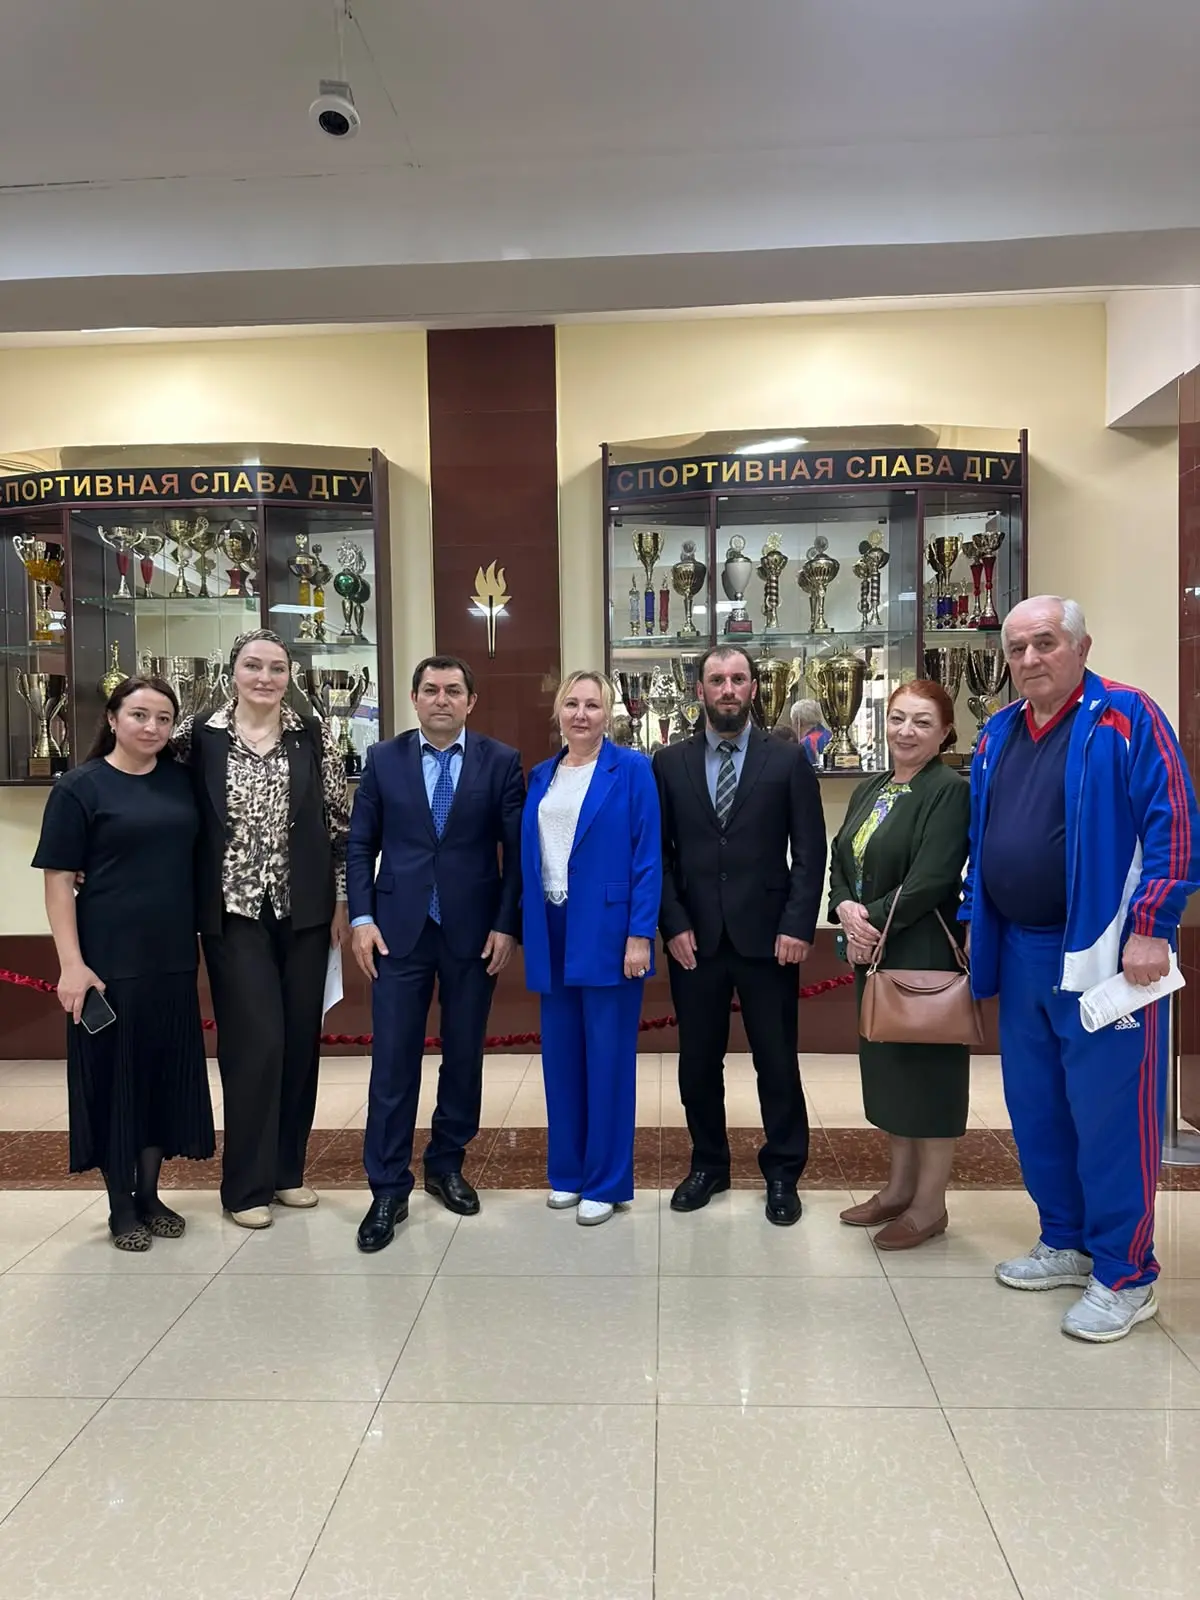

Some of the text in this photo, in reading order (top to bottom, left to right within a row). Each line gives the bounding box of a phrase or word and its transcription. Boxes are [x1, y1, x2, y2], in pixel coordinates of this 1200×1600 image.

[0, 471, 367, 503] ПОРТИВНАЯ СЛАВА ДГУ
[616, 454, 1017, 492] СПОРТИВНАЯ СЛАВА ДГУ
